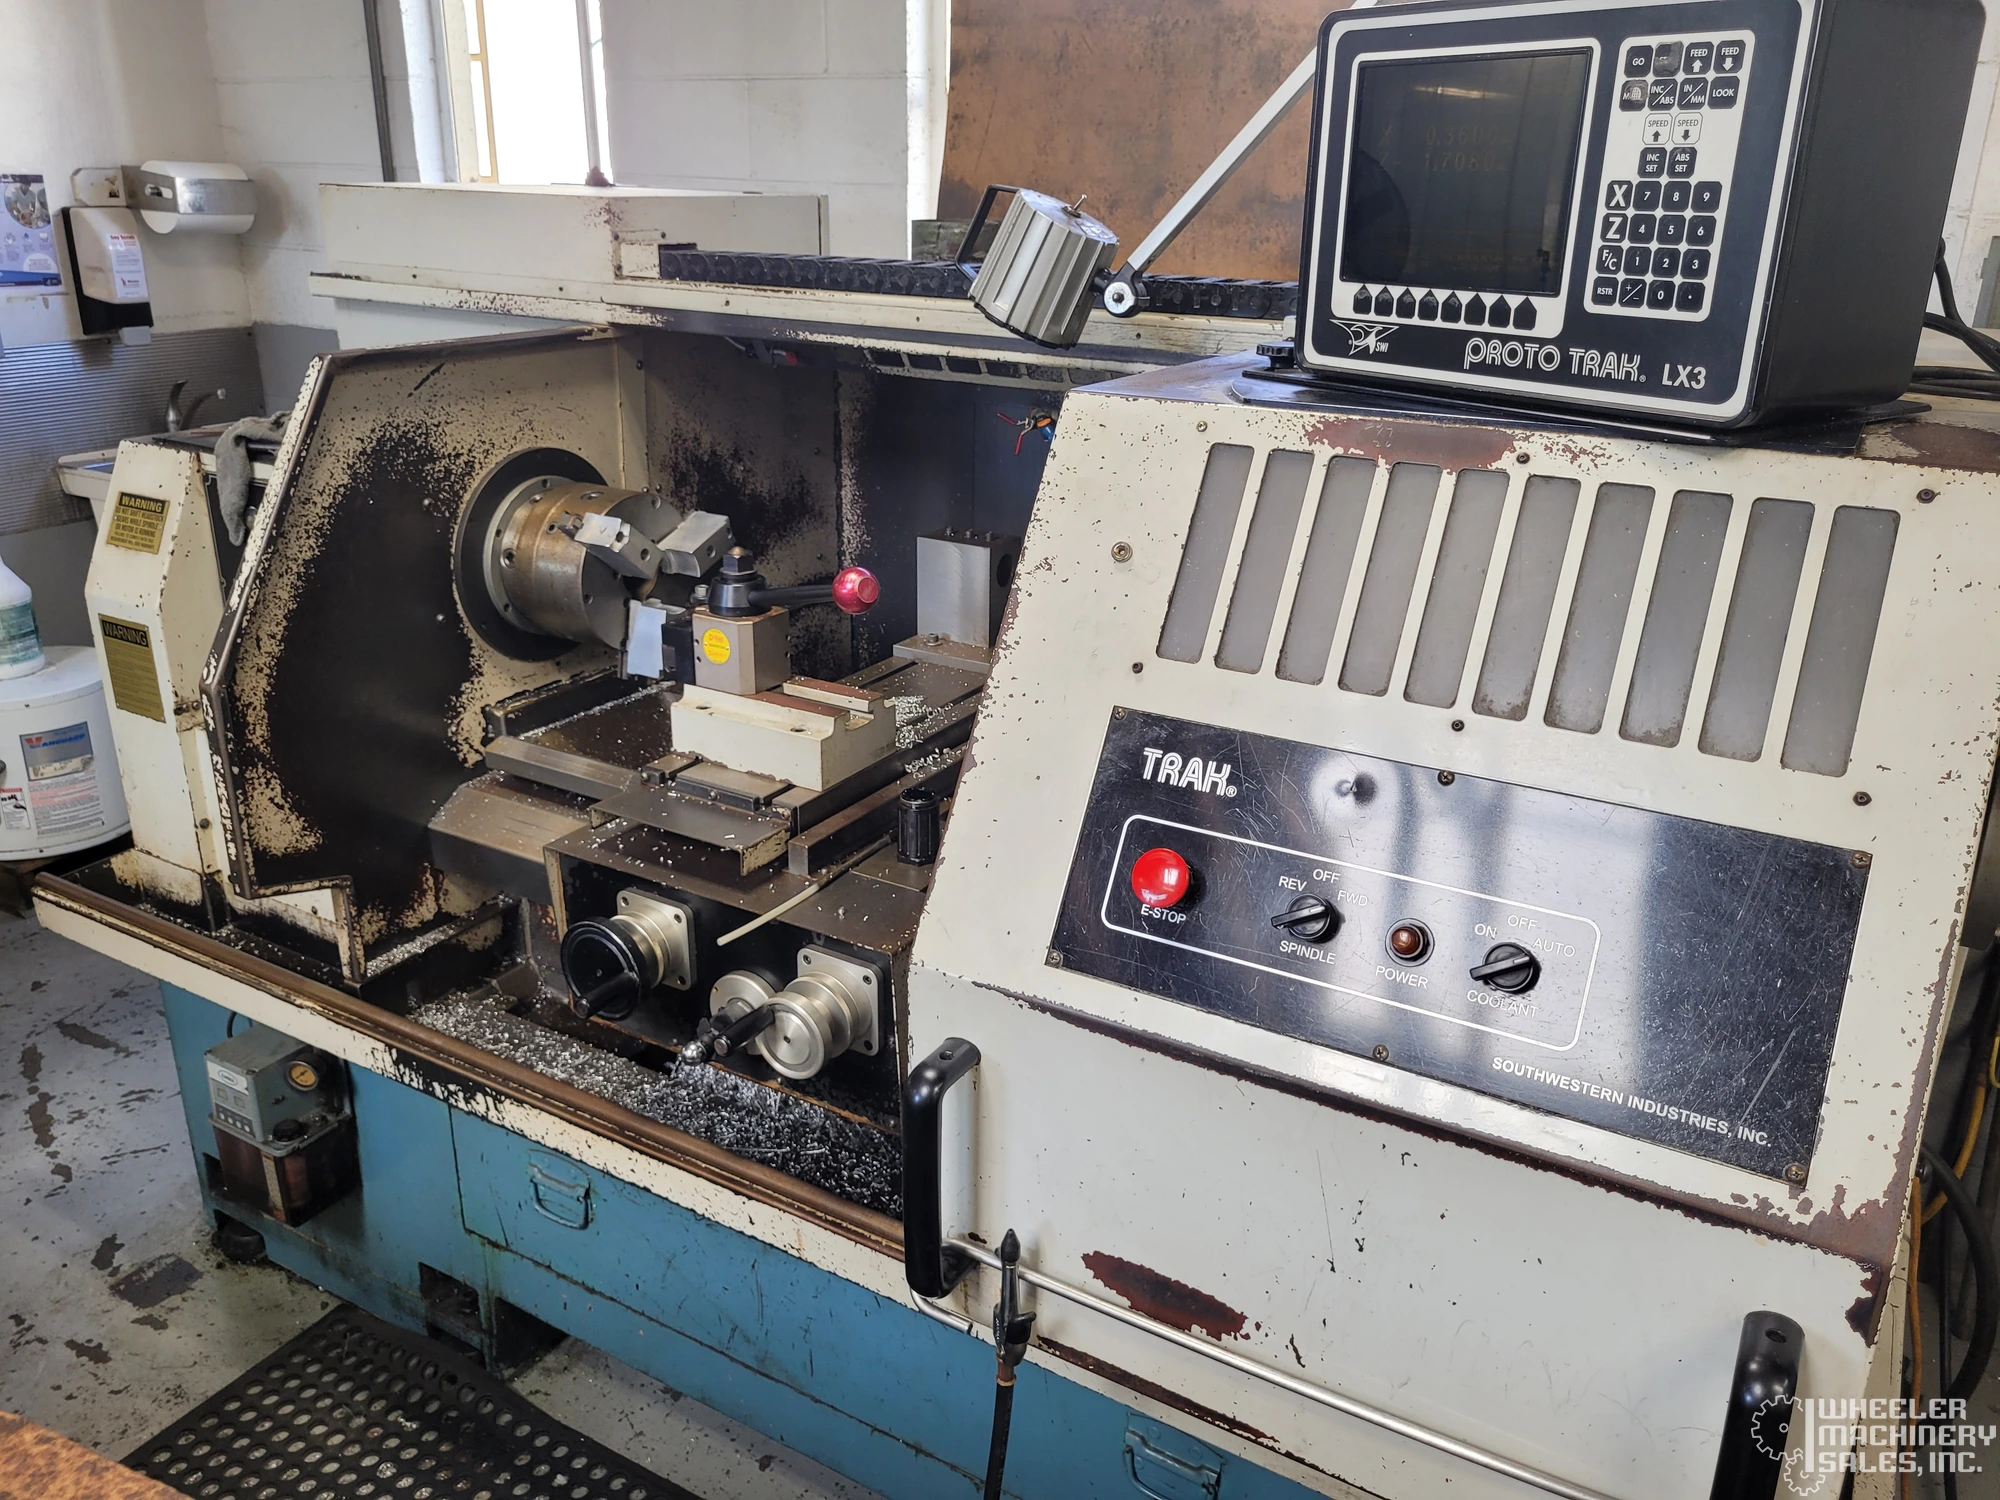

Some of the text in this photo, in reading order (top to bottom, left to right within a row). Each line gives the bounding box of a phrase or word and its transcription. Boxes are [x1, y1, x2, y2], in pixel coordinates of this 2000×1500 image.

[1690, 48, 1708, 57] FEED
[1721, 47, 1740, 56] FEED
[1632, 58, 1645, 66] GO
[1651, 85, 1664, 94] INC
[1683, 84, 1693, 93] IN
[1712, 88, 1735, 97] LOOK
[1660, 96, 1675, 104] ABS
[1690, 95, 1705, 104] MM
[1647, 119, 1669, 128] SPEED
[1677, 119, 1699, 127] SPEED
[1646, 153, 1660, 162] INC
[1675, 153, 1690, 162] ABS
[1645, 164, 1658, 172] SET
[1674, 164, 1688, 173] SET
[1609, 184, 1628, 207] X
[1643, 191, 1651, 201] 7
[1672, 192, 1680, 202] 8
[1703, 192, 1710, 202] 9
[1605, 217, 1623, 239] Z
[1638, 224, 1646, 233] 4
[1667, 225, 1674, 235] 5
[1697, 226, 1704, 236] 6
[1635, 256, 1640, 266] 1
[1662, 258, 1669, 268] 2
[1691, 260, 1699, 269] 3
[1597, 287, 1613, 296] RSTR
[1657, 290, 1664, 300] 0
[1375, 341, 1389, 353] SWI
[1463, 337, 1561, 371] PROTO
[1661, 363, 1707, 390] LX3
[121, 495, 163, 513] WARNING
[103, 621, 147, 646] WARNING
[1278, 868, 1368, 907] REV OFF FWD
[1140, 904, 1187, 924] E-STOP
[1474, 915, 1576, 957] ON OFF AUTO
[1279, 940, 1337, 965] SPINDLE
[1375, 965, 1429, 990] POWER
[1466, 989, 1539, 1018] COOLANT
[1492, 1056, 1772, 1148] SOUTHWESTERN INDUSTRIES, INC.
